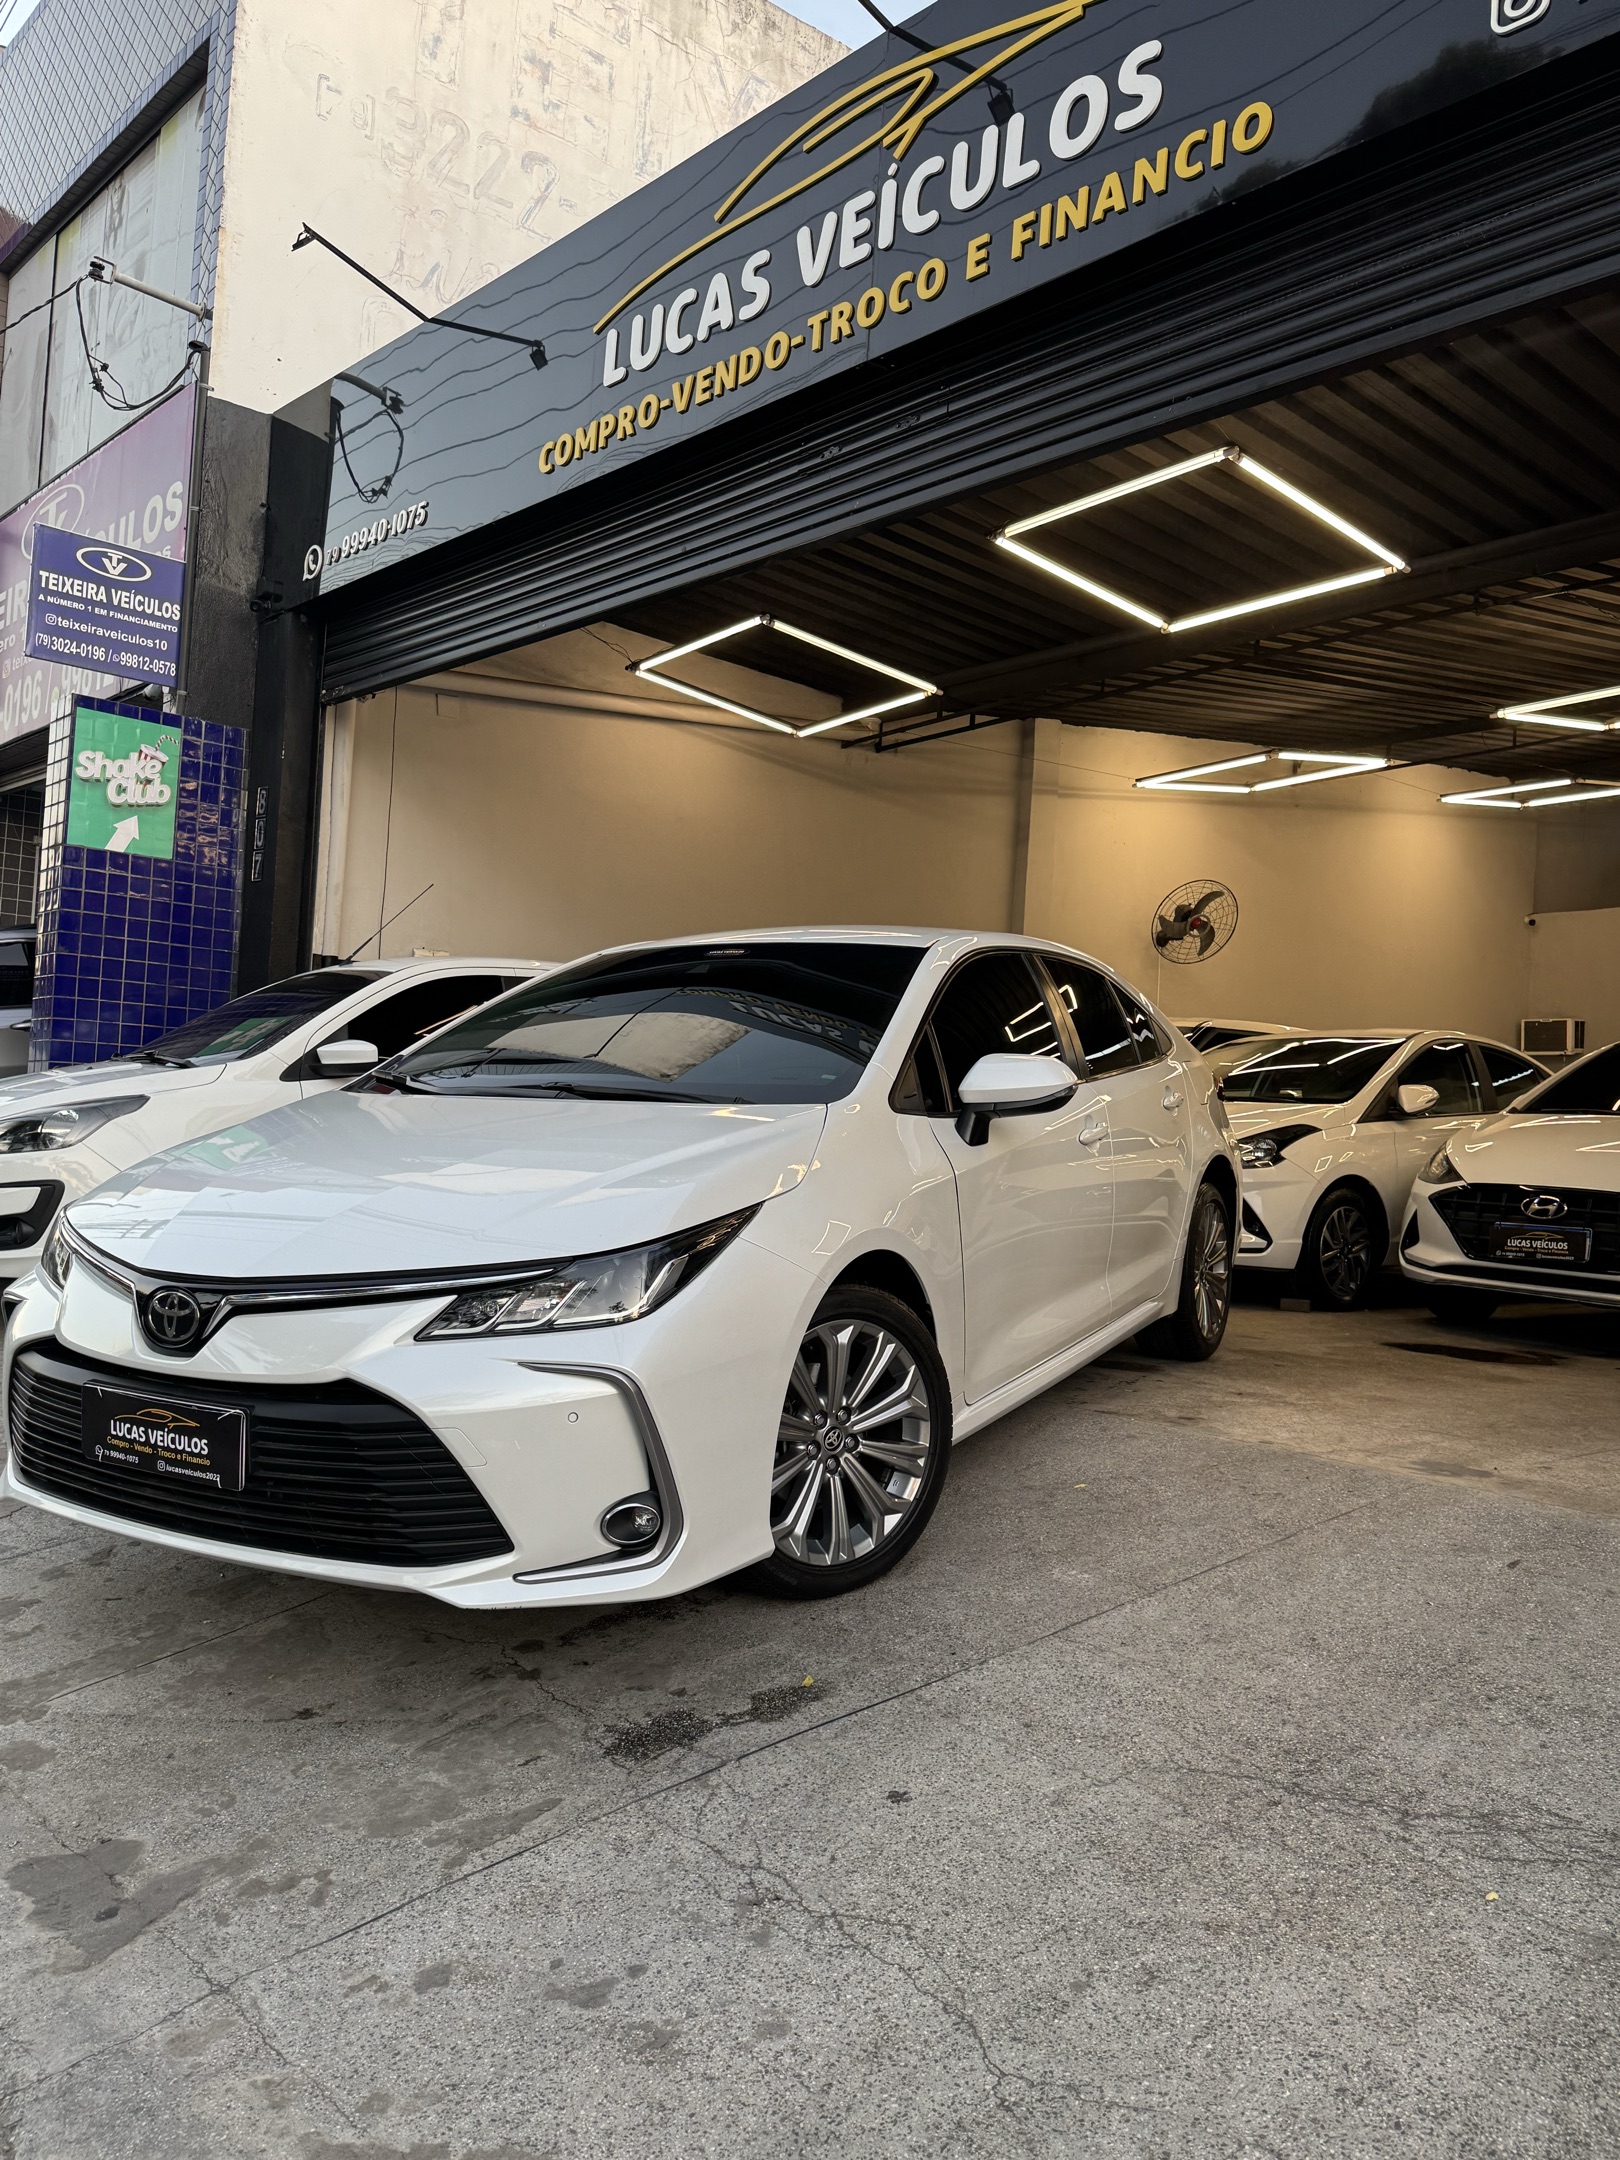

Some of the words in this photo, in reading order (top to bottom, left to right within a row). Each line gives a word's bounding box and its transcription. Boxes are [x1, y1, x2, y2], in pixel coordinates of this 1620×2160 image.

[603, 249, 771, 386] LUCAS
[795, 40, 1163, 287] VEÍCULOS
[538, 257, 946, 475] COMPRO-VENDO-TROCO
[965, 233, 990, 282] E
[1010, 101, 1274, 260] FINANCIO
[326, 546, 340, 565] 79
[341, 501, 428, 558] 99940-1075
[39, 570, 107, 603] TEIXEIRA
[111, 588, 181, 620] VEÍCULOS
[38, 593, 45, 601] A
[47, 594, 85, 611] NÚMERO
[94, 607, 107, 615] EM
[109, 610, 178, 633] FINANCIAMENTO
[57, 616, 168, 651] teixeiraveiculos10
[120, 651, 176, 677] 99812-0578
[75, 750, 163, 783] Shake
[107, 777, 172, 807] Club
[1507, 1238, 1531, 1247] LUCAS
[1532, 1239, 1569, 1250] VEÍCULOS
[107, 1436, 130, 1450] Compro
[133, 1442, 153, 1455] Vendo
[158, 1448, 176, 1460] Troco
[182, 1453, 211, 1467] Financio
[110, 1419, 146, 1443] LUCAS
[148, 1427, 209, 1455] VEÍCULOS
